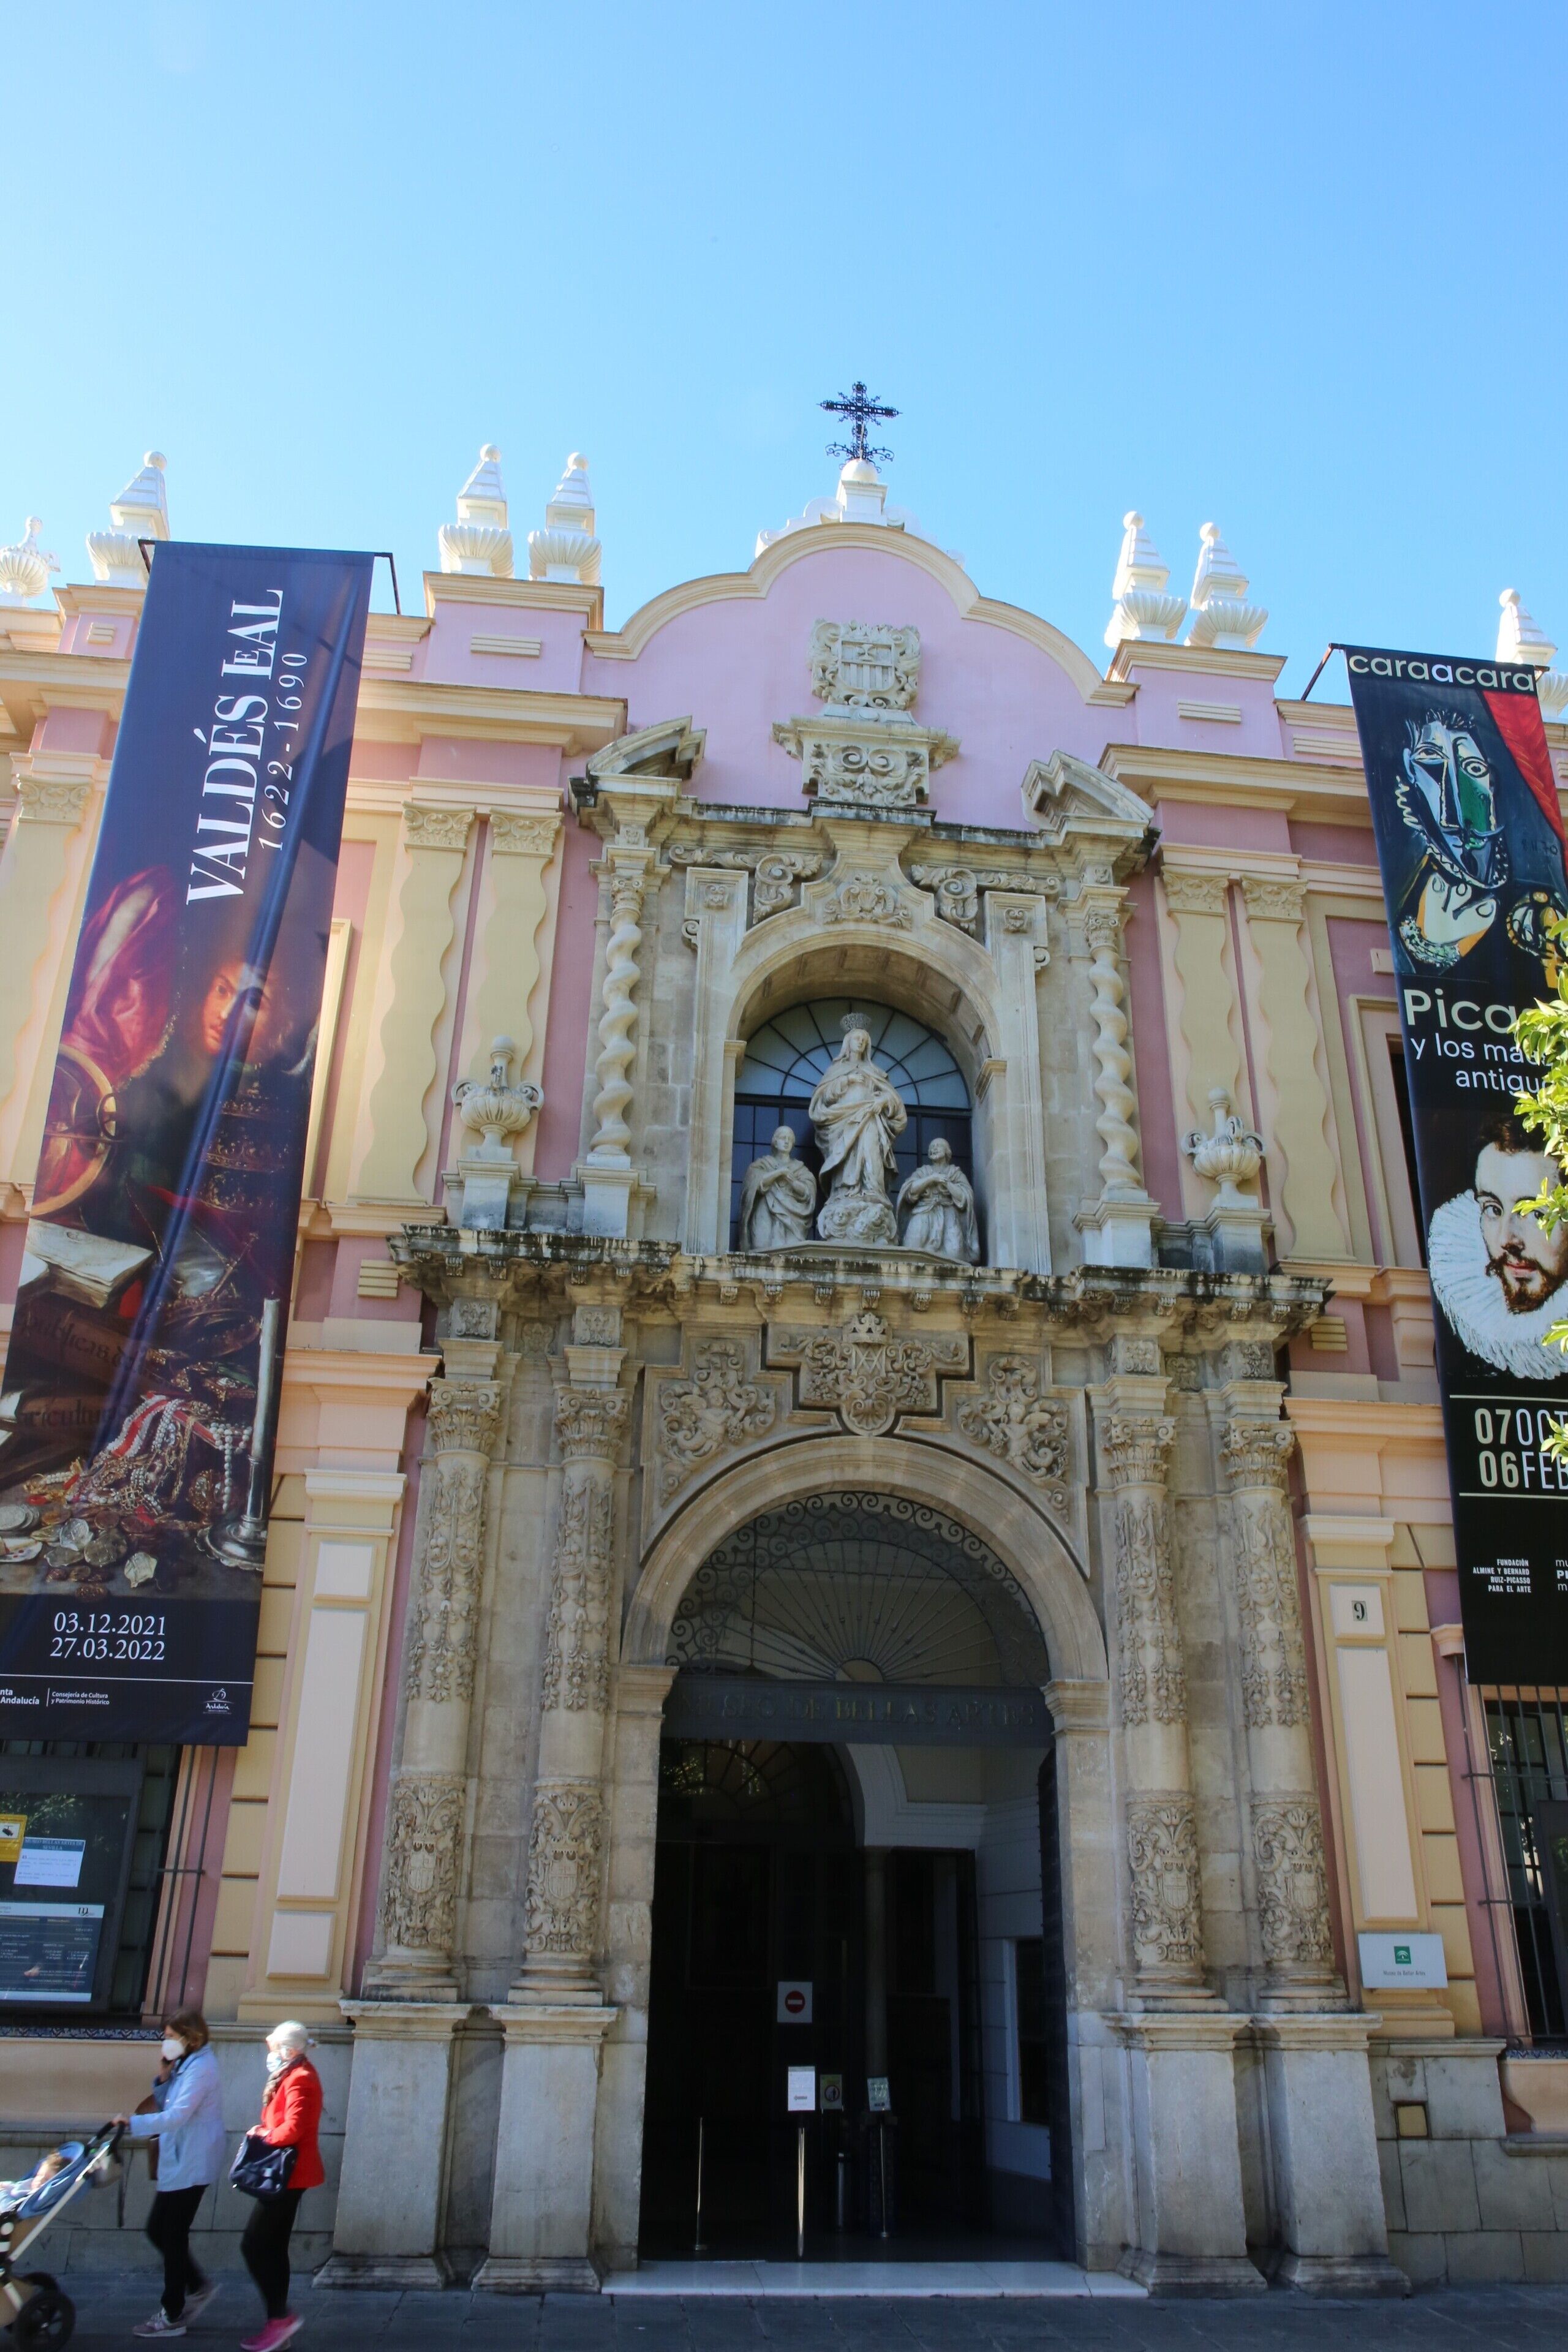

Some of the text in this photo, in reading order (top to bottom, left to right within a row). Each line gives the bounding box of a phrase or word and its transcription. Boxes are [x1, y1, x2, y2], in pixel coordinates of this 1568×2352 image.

[258, 653, 307, 851] 1622-1690
[186, 695, 269, 905] VALDÉS
[1403, 988, 1534, 1034] Pica
[1411, 1038, 1426, 1060] y
[1435, 1033, 1476, 1059] los
[1455, 1068, 1547, 1096] antigu
[1496, 1558, 1529, 1567] FUNDACIÓN
[53, 1611, 165, 1636] 03.12.2021
[1354, 1602, 1365, 1621] 9
[50, 1637, 165, 1660] 27.03.2022
[0, 1696, 40, 1705] Andalucía
